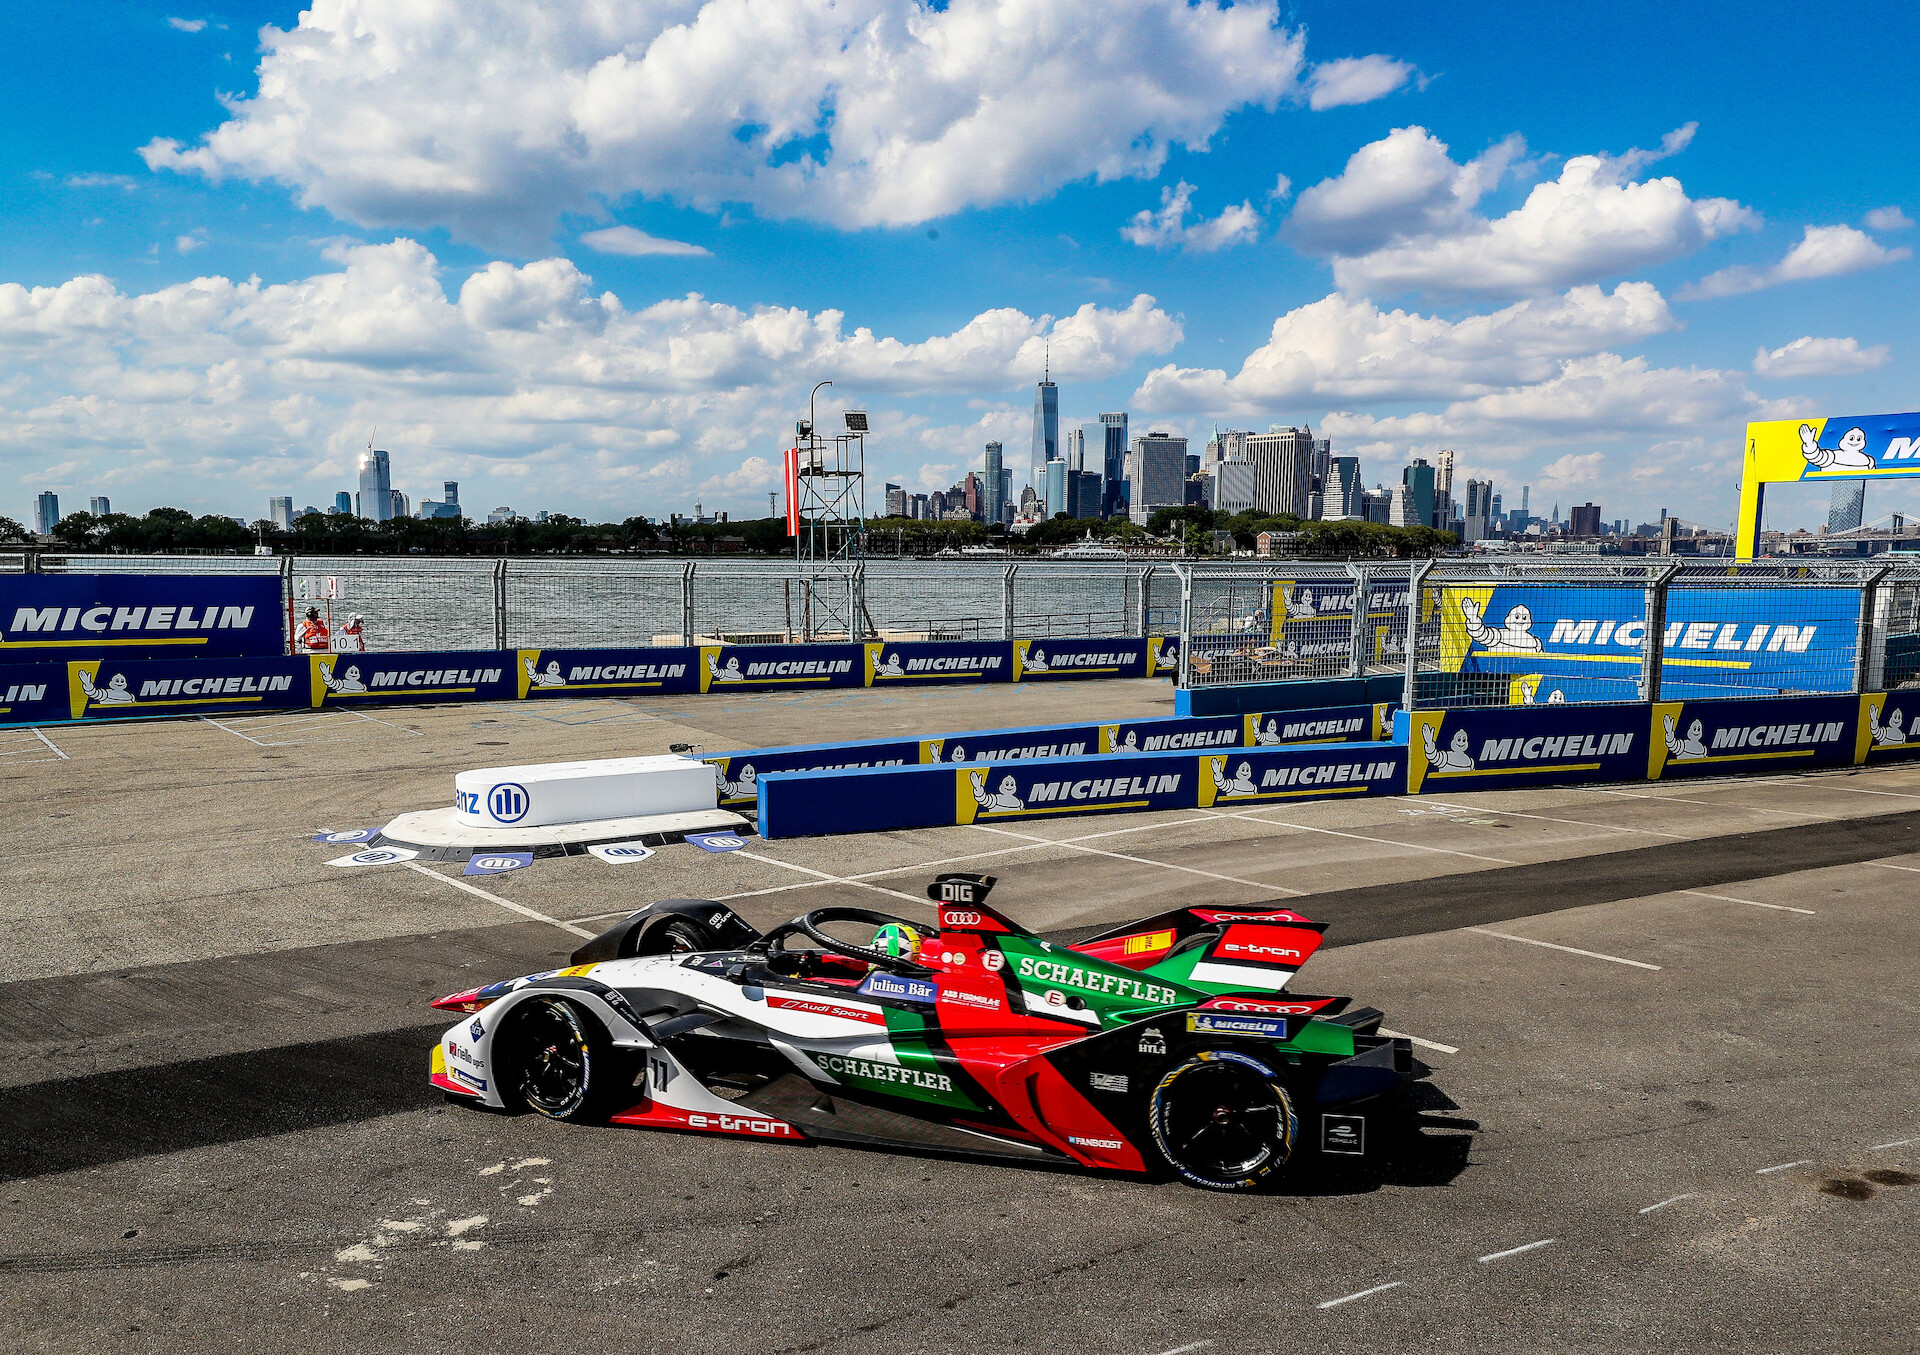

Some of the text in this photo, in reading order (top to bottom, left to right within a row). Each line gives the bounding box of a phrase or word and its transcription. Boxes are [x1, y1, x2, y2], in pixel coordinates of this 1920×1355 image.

[10, 605, 254, 632] MICHELIN
[331, 637, 359, 649] 10.1
[746, 659, 853, 676] MICHELIN
[906, 655, 1002, 671] MICHELIN
[1050, 651, 1137, 667] MICHELIN
[370, 668, 502, 687] MICHELIN
[568, 663, 687, 681] MICHELIN
[0, 684, 47, 702] IN
[139, 675, 293, 697] MICHELIN
[1282, 717, 1364, 739] MICHELIN
[1710, 721, 1844, 750] MICHELIN
[1143, 728, 1237, 751] MICHELIN
[1478, 732, 1635, 762] MICHELIN
[1261, 761, 1397, 786] MICHELIN
[1028, 774, 1181, 802] MICHELIN
[941, 883, 974, 902] DIG
[1224, 942, 1300, 957] e-tron
[987, 953, 999, 967] E
[868, 977, 934, 997] Julius Bär
[1019, 957, 1177, 1005] SCHAEFFLER
[1048, 992, 1061, 1004] E
[799, 1001, 870, 1020] Audi Sport
[1214, 1020, 1278, 1032] MICHELIN
[1138, 1044, 1166, 1054] HYLA
[650, 1056, 668, 1092] 11
[817, 1054, 953, 1092] SCHAEFFLER
[688, 1114, 790, 1135] e-tron
[1075, 1137, 1123, 1149] FANBOOST
